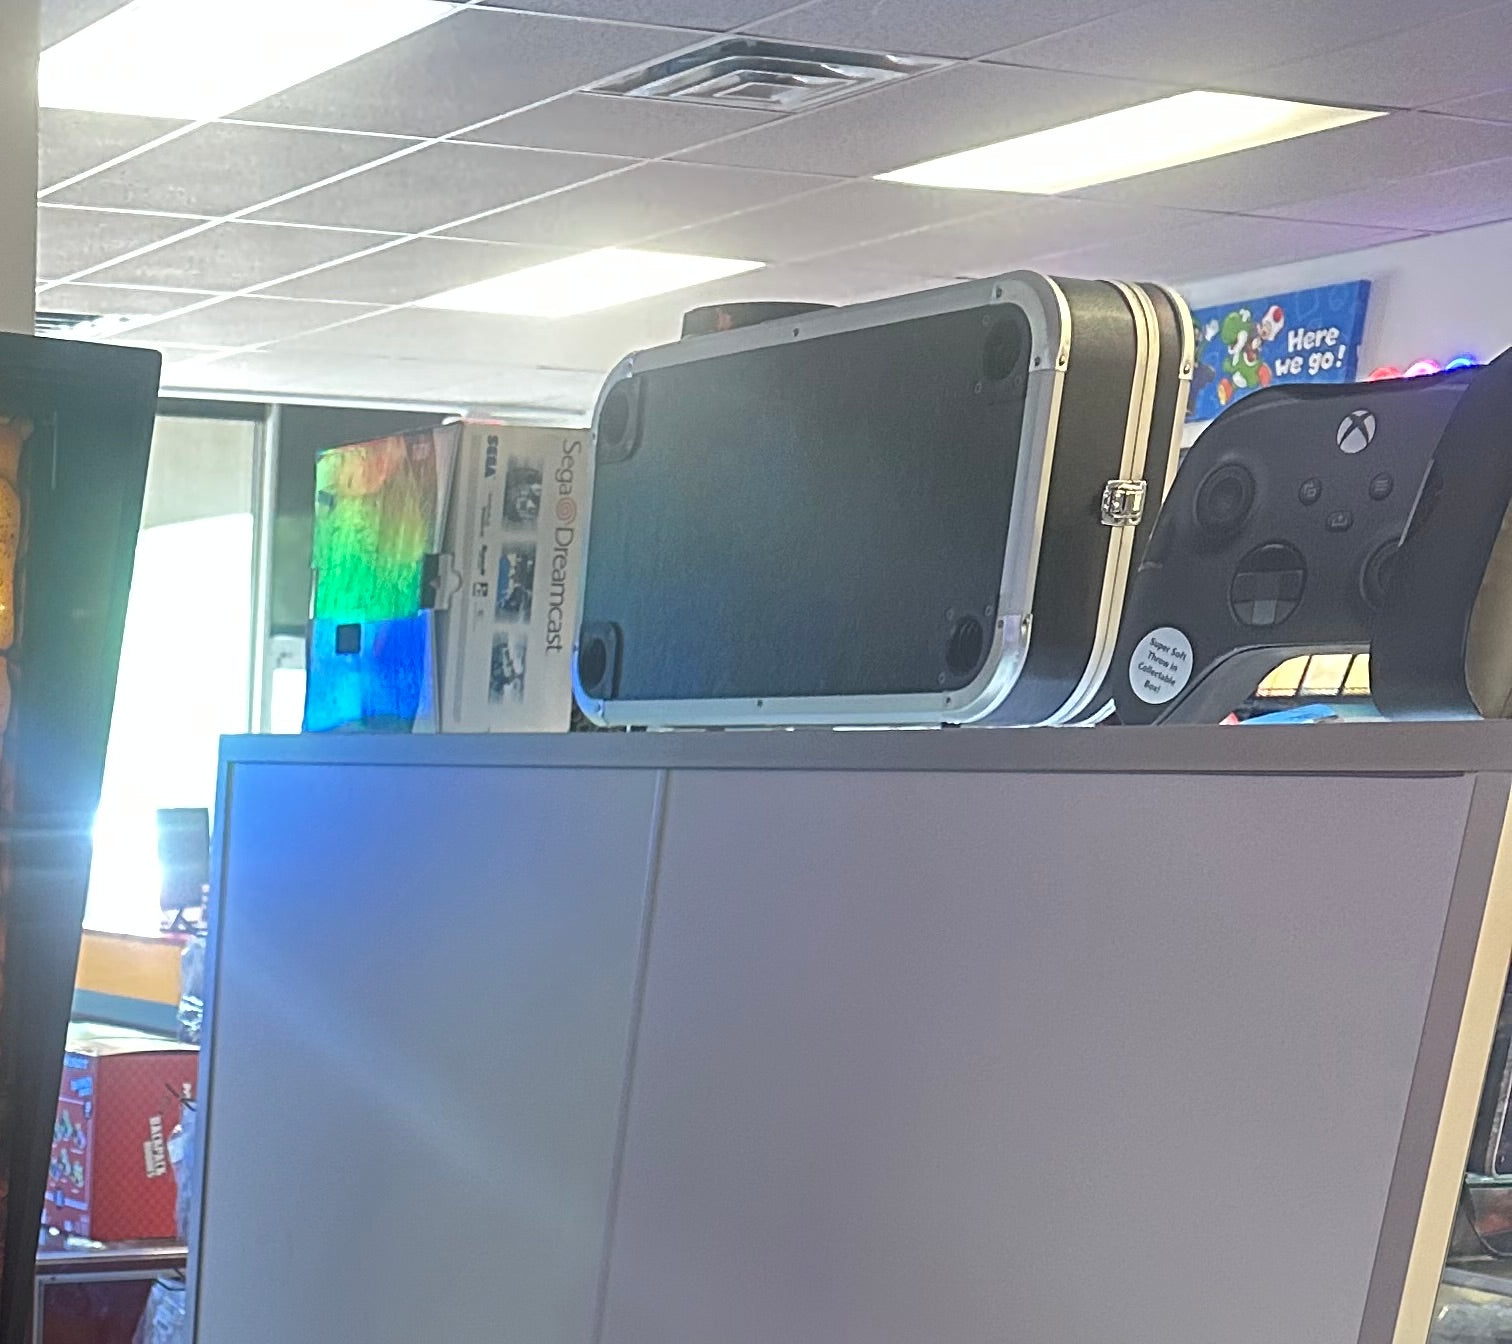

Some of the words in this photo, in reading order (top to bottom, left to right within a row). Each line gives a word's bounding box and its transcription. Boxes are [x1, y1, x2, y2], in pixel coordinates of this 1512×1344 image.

[1288, 327, 1340, 352] Here
[1275, 356, 1303, 376] we
[1308, 344, 1346, 375] go!
[555, 440, 582, 496] Sega
[546, 527, 575, 654] Dreamcast
[1150, 637, 1171, 653] Super
[1171, 647, 1187, 662] Soft
